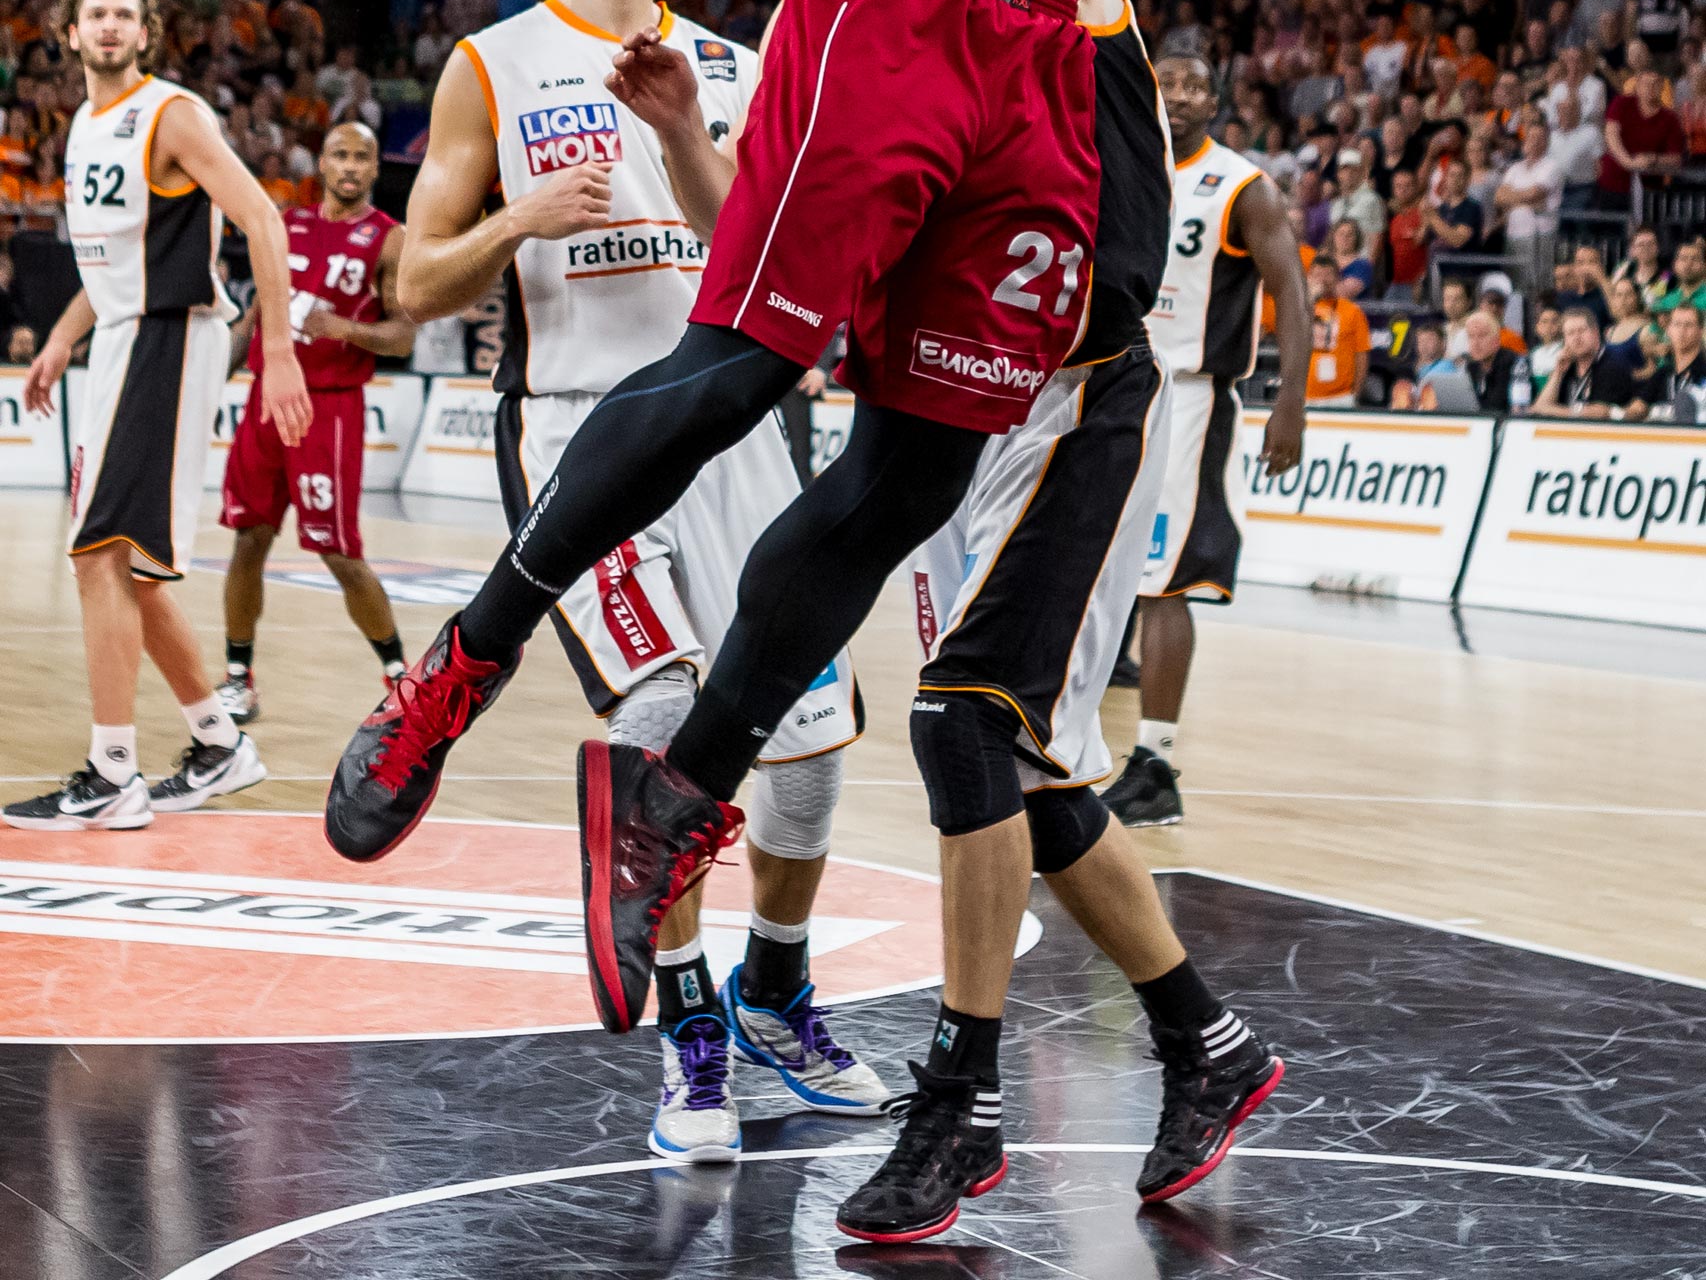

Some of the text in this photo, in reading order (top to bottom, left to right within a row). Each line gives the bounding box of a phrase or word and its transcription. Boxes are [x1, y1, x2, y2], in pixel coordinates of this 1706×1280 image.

[555, 76, 585, 88] JAKO
[523, 104, 616, 142] LIQUI
[530, 132, 620, 176] MOLY
[83, 163, 126, 207] 52
[325, 253, 367, 296] 13
[991, 230, 1084, 315] 21
[767, 291, 823, 327] SPALDING
[297, 473, 334, 512] 13
[612, 604, 652, 657] FRITZ
